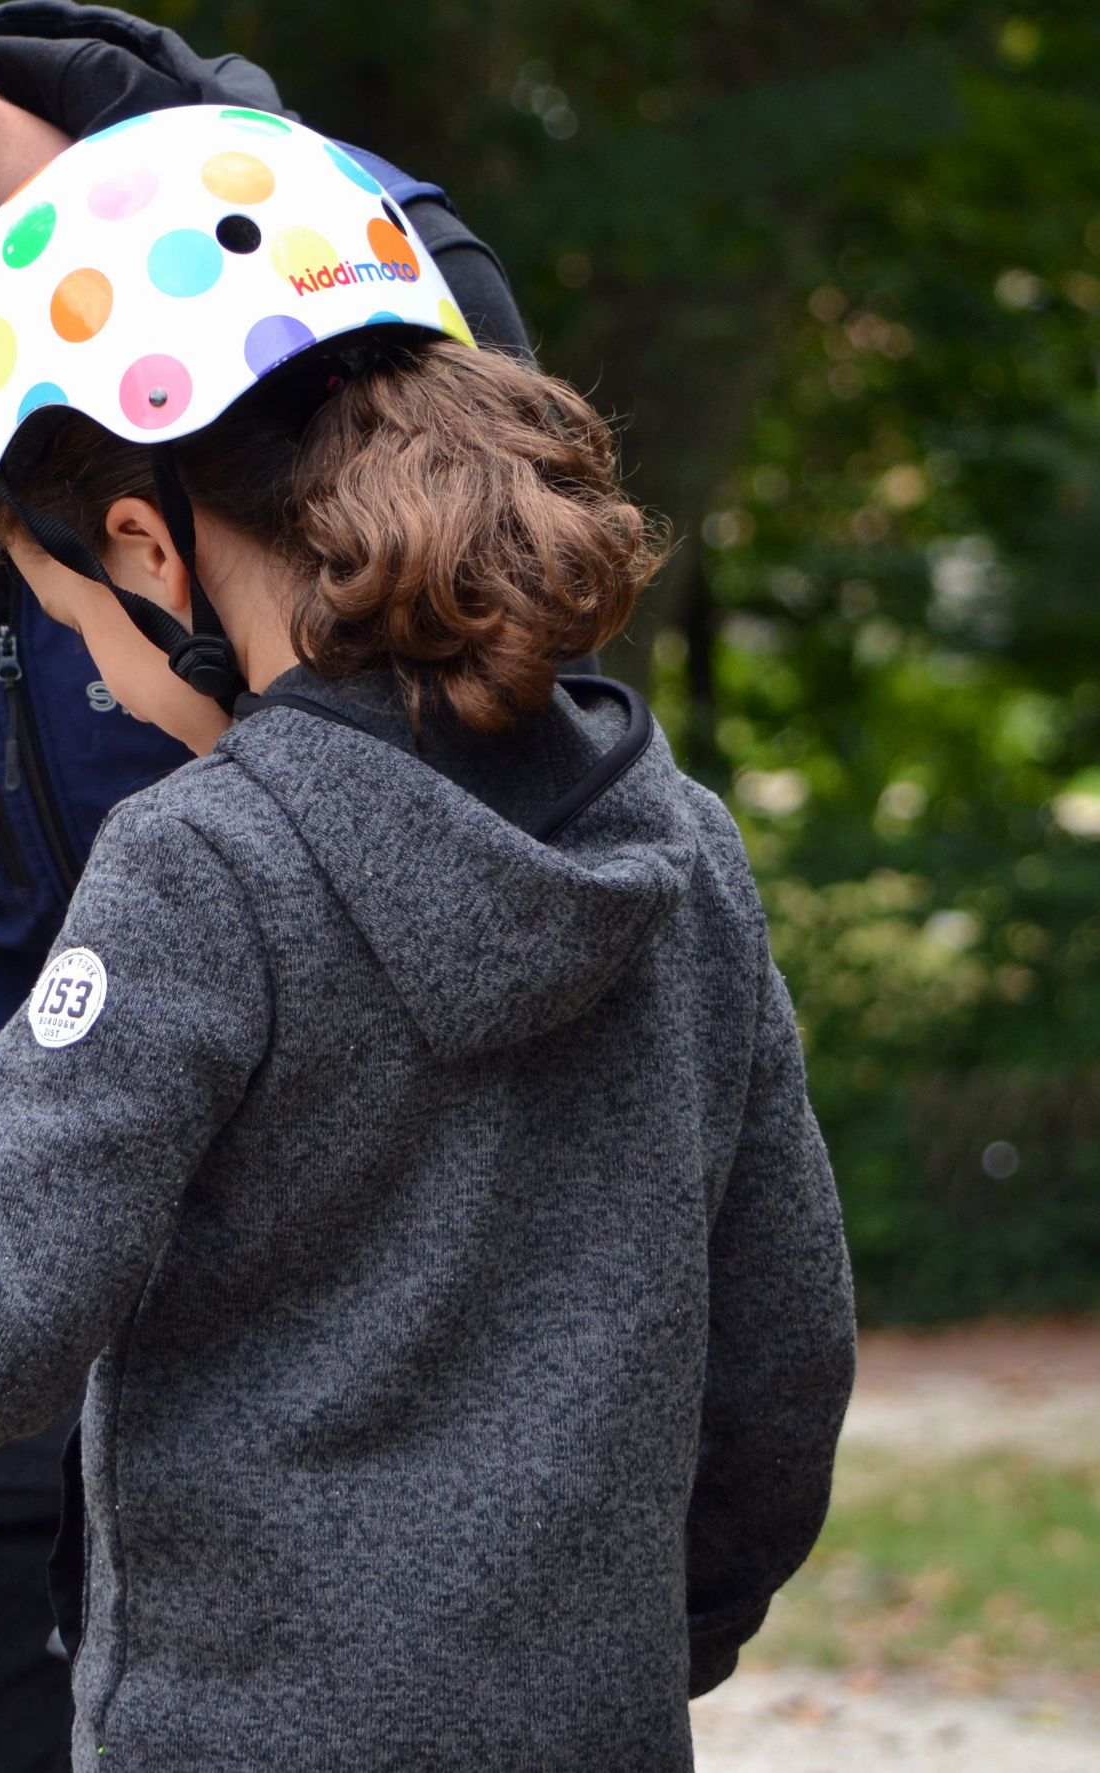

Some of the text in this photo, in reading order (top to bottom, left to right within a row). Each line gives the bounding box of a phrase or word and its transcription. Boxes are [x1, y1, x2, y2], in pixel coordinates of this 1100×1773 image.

[288, 259, 417, 296] kiddimoto
[54, 958, 98, 978] NEW YORK
[38, 977, 93, 1019] 153
[39, 1016, 76, 1030] BOROUGH
[43, 1028, 60, 1038] DIST
